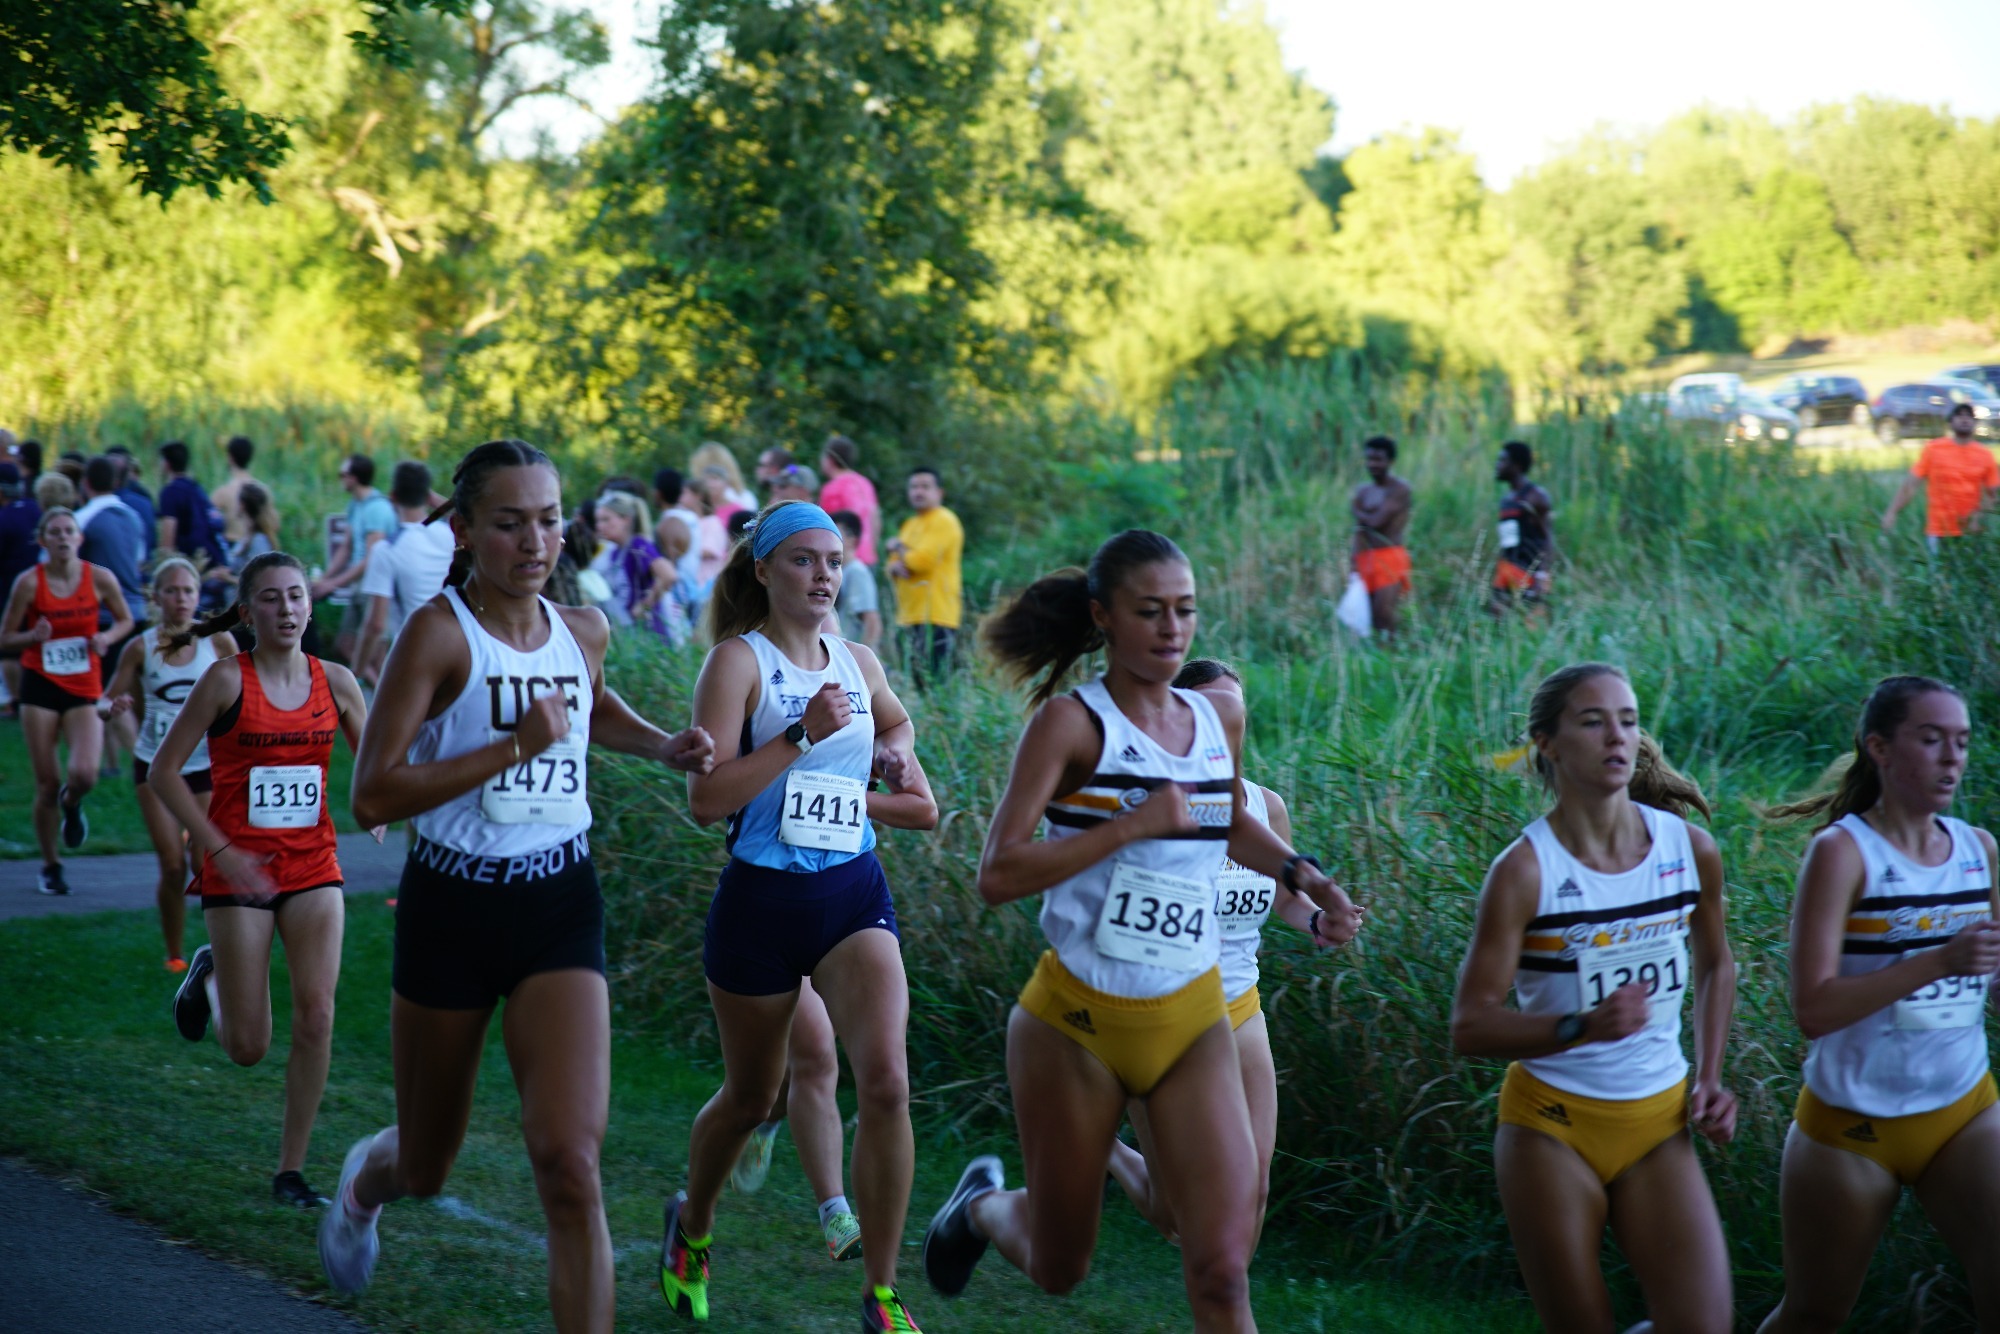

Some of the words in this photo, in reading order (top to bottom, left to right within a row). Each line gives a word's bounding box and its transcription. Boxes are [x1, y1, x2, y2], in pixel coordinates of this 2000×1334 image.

[238, 731, 309, 748] GOVERNORS
[492, 756, 579, 794] 1473
[254, 782, 318, 808] 1319
[789, 791, 861, 828] 1411
[420, 842, 501, 884] NIKE
[503, 845, 565, 884] PRO
[1109, 891, 1205, 943] 1384
[1903, 974, 1982, 1001] 94
